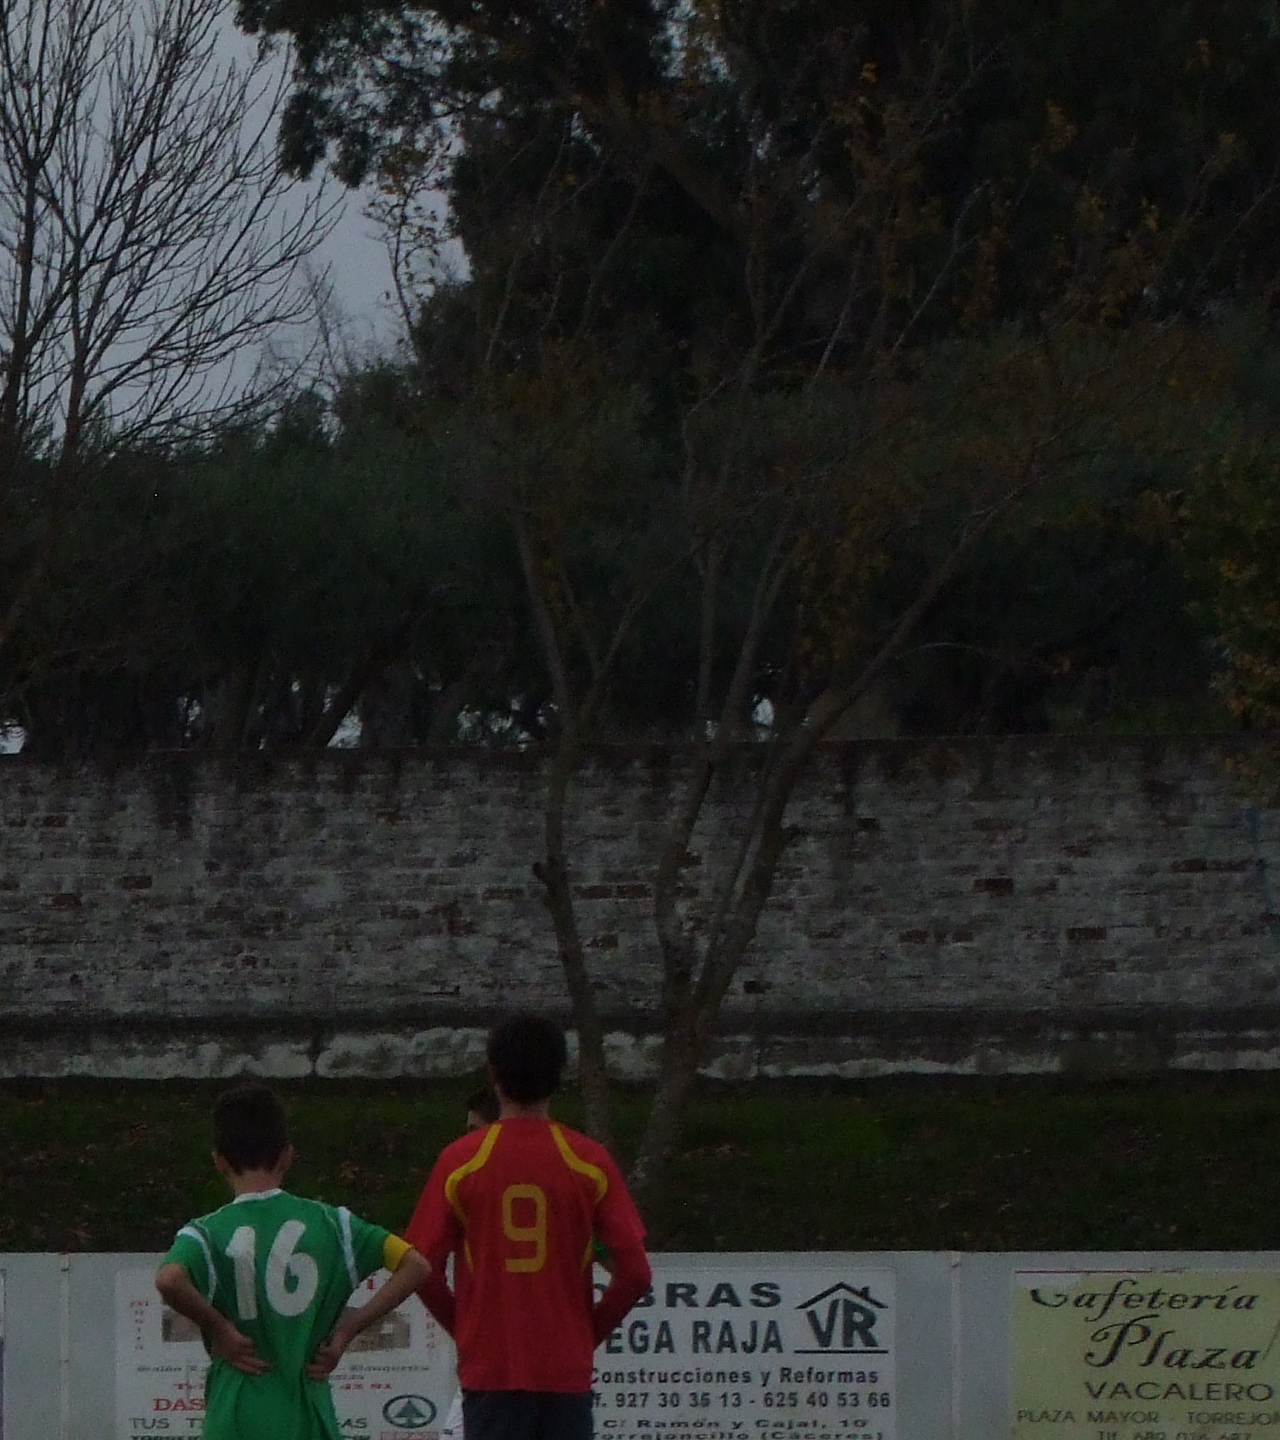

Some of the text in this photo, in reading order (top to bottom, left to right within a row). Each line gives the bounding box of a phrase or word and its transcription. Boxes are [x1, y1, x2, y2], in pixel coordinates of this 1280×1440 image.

[501, 1183, 547, 1274] 9
[224, 1218, 319, 1321] 16
[1030, 1278, 1260, 1323] Cafetería
[604, 1319, 785, 1355] EGA RAJA
[806, 1298, 880, 1348] VR
[1084, 1313, 1262, 1370] Plaza
[590, 1366, 880, 1388] Construcciones y Reformas
[1084, 1381, 1274, 1402] VACALERO
[615, 1391, 650, 1408] 927
[658, 1391, 681, 1408] 30
[719, 1391, 742, 1408] 13
[764, 1391, 799, 1408] 625
[806, 1391, 829, 1408] 40
[836, 1391, 861, 1408] 53
[867, 1391, 890, 1408] 66
[1016, 1410, 1076, 1424] PLAZA
[1087, 1411, 1160, 1424] MAYOR
[637, 1417, 721, 1429] Ramón
[731, 1420, 744, 1431] y
[838, 1418, 868, 1429] 10
